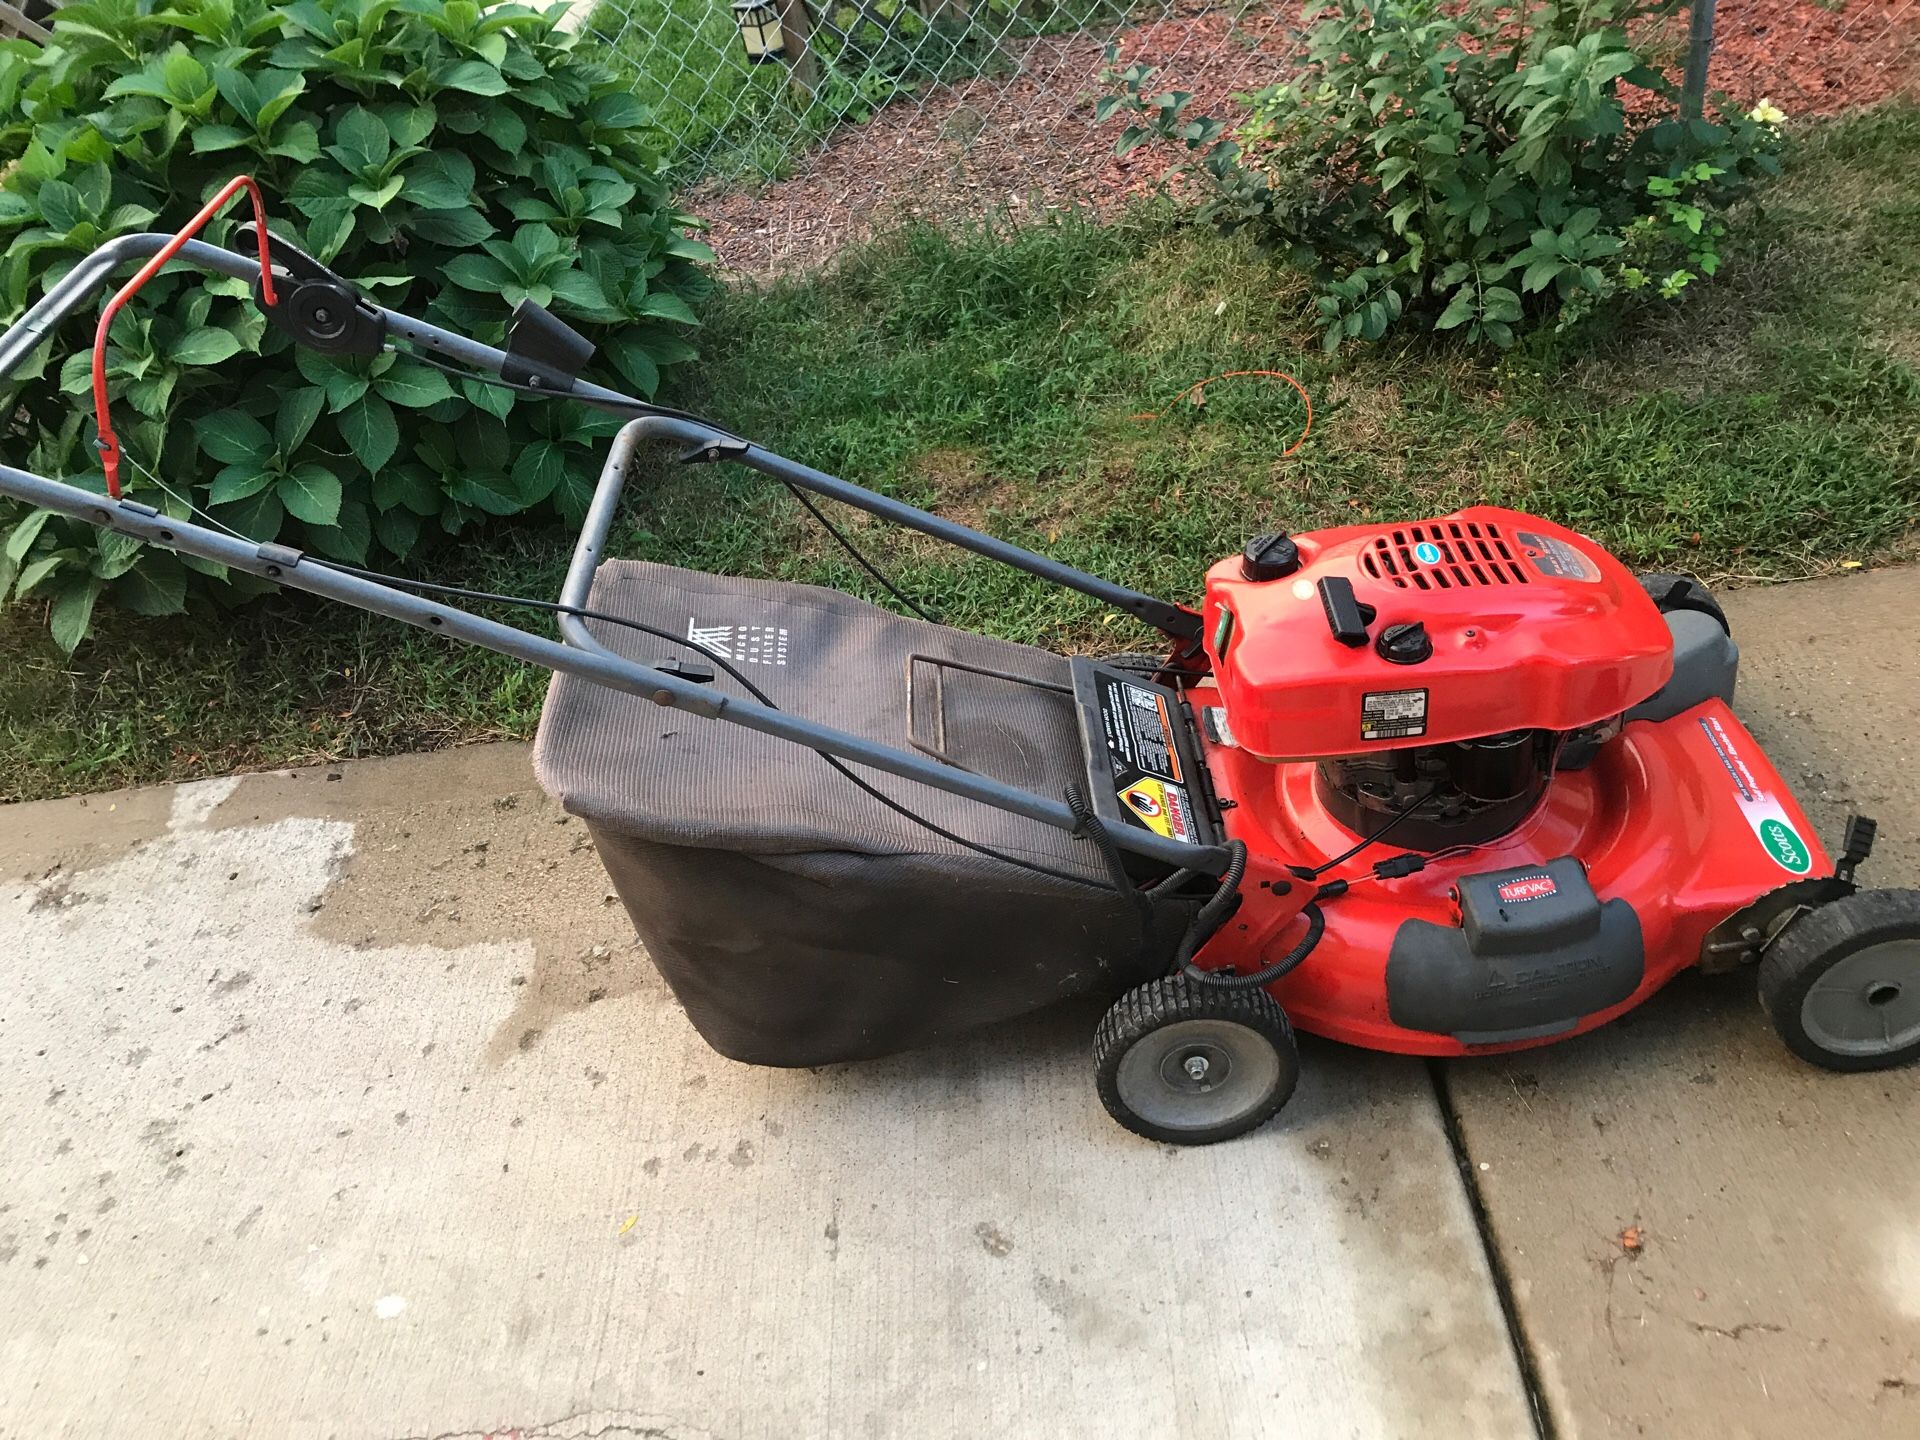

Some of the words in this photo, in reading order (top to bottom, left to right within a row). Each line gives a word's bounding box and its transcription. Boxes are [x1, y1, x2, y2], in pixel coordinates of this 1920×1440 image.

[736, 625, 748, 661] MICRO
[749, 625, 761, 663] DUST
[763, 626, 775, 665] FILTER
[777, 628, 788, 666] SYSTEM
[1709, 717, 1723, 732] Start
[1720, 732, 1738, 756] Electric
[1734, 759, 1758, 790] Propelled
[1166, 791, 1185, 836] DANGER
[1768, 824, 1801, 865] Scotts
